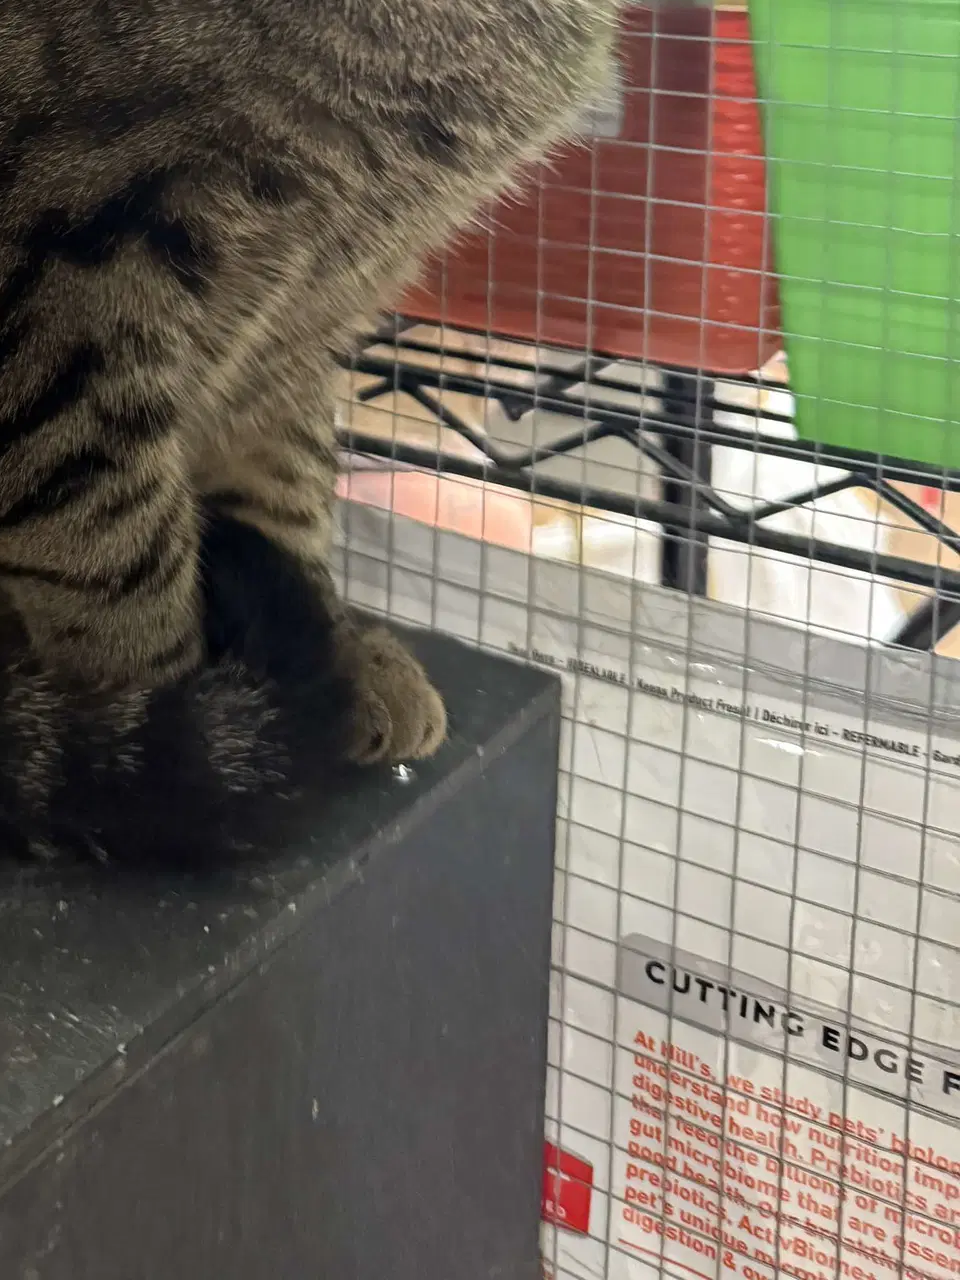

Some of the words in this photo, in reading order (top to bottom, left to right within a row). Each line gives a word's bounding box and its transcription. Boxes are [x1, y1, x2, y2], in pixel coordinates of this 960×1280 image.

[842, 728, 920, 758] REFERMABLE
[645, 960, 804, 1036] CUTTING
[822, 1024, 925, 1085] EDGE
[633, 1030, 656, 1052] At
[660, 1040, 717, 1081] Hill's,
[727, 1075, 755, 1095] we
[760, 1085, 822, 1120] study
[633, 1054, 749, 1116] understand
[756, 1103, 802, 1135] how
[628, 1140, 678, 1171] good
[630, 1118, 662, 1143] gut
[667, 1135, 790, 1202] microbiome
[847, 1215, 887, 1241] are
[631, 1073, 723, 1128] digestive
[728, 1116, 803, 1160] healh.
[811, 1148, 928, 1211] Prebiotics
[632, 1093, 665, 1121] tha
[725, 1140, 759, 1167] the
[765, 1156, 847, 1201] bllions
[854, 1193, 879, 1214] of
[622, 1206, 717, 1261] digestion
[722, 1249, 737, 1272] &
[624, 1185, 674, 1217] pet's
[679, 1209, 748, 1255] unique
[738, 1215, 876, 1280] ActvBiome+
